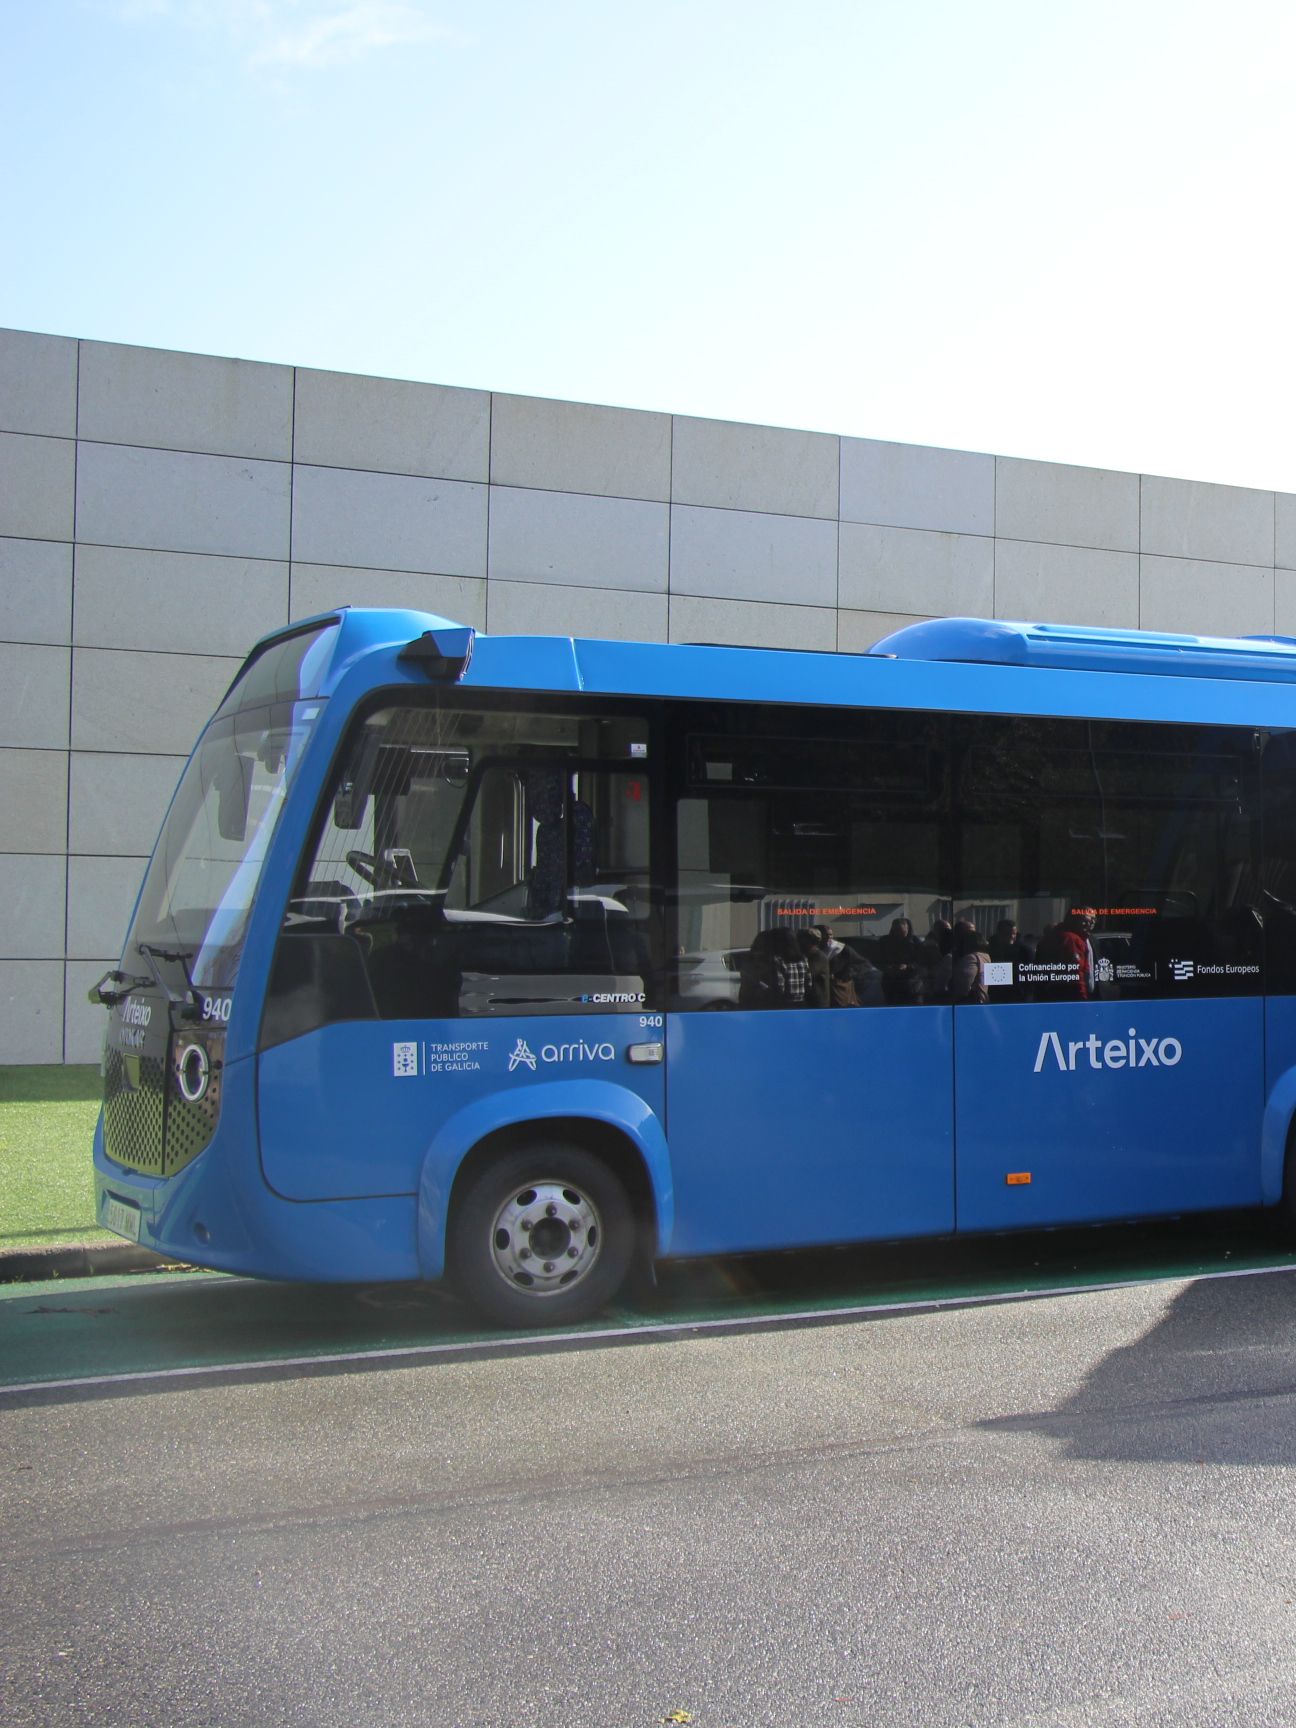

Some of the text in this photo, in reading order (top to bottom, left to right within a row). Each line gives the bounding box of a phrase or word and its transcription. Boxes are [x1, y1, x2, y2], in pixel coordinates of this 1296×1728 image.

[1019, 963, 1080, 972] Cofinanciado por
[1197, 964, 1260, 975] Fondos Europeos
[1018, 973, 1080, 983] la Unión Europea
[123, 996, 152, 1027] Arteixo
[202, 996, 233, 1022] 940
[639, 1015, 663, 1028] 940
[430, 1041, 489, 1052] TRANSPORTE
[541, 1039, 615, 1062] arriva
[1033, 1027, 1183, 1073] Arteixo
[431, 1051, 469, 1062] PÚBLICO
[431, 1062, 481, 1072] DE GALICIA
